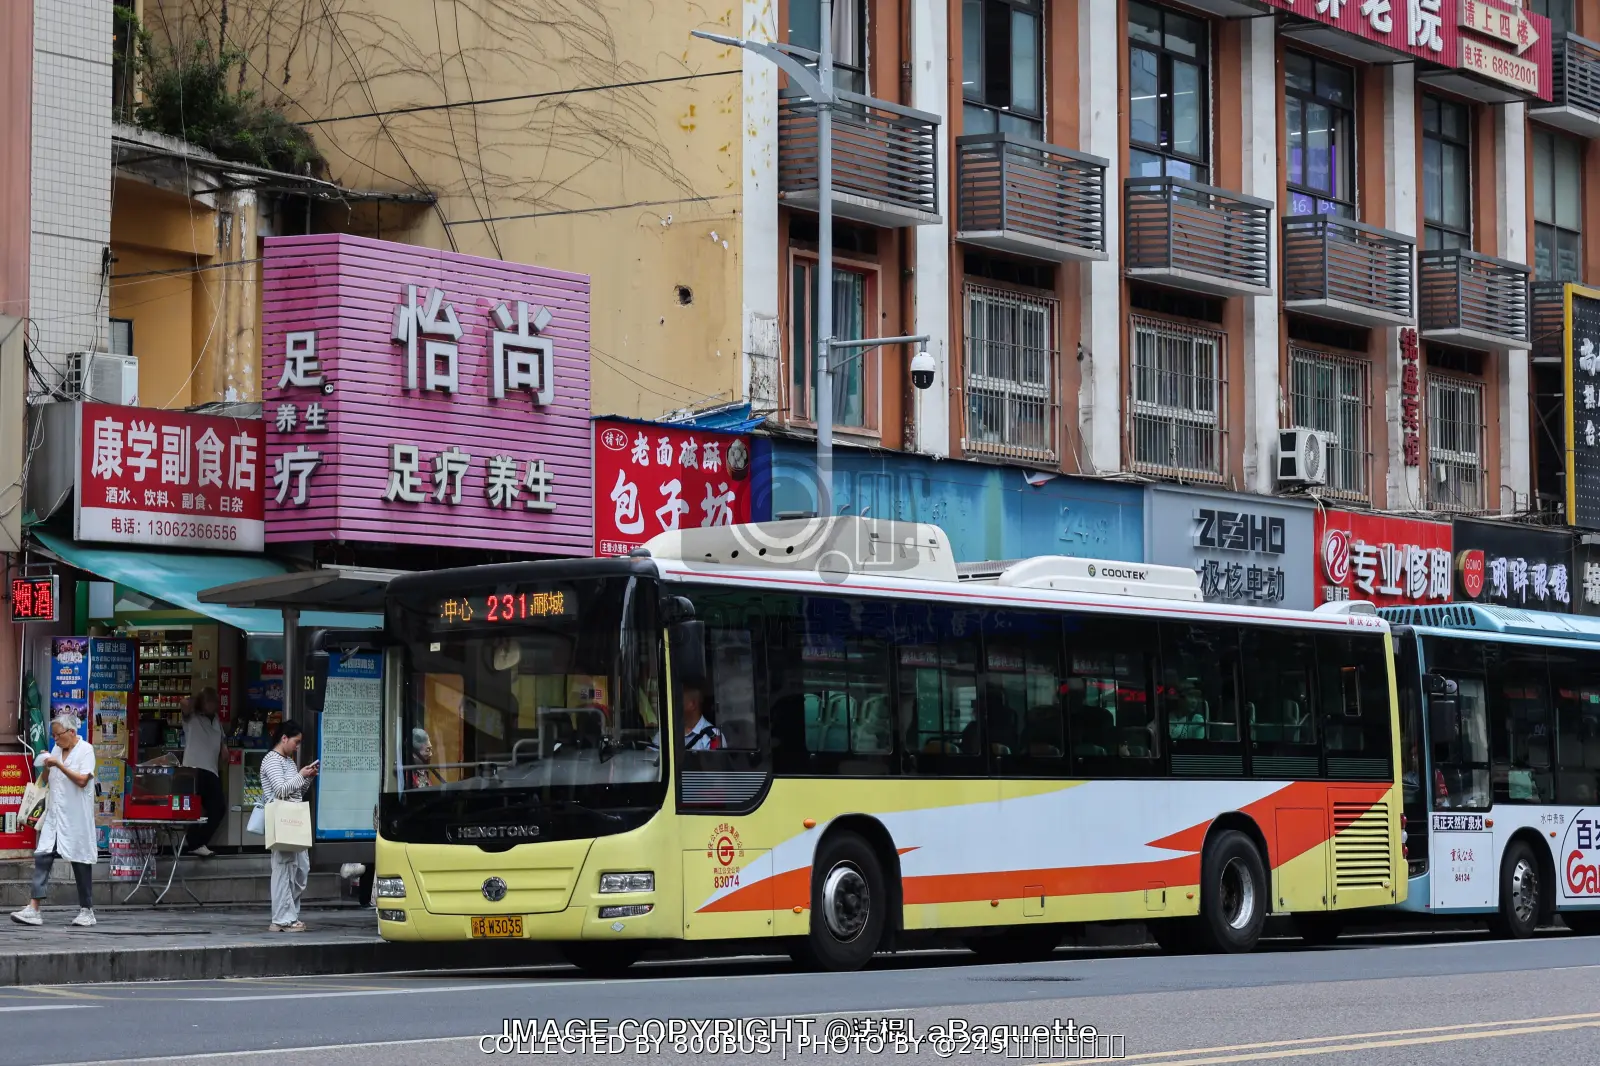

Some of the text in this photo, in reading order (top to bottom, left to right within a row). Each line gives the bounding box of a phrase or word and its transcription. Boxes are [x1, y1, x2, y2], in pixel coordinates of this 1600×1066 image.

[391, 283, 555, 406] 怡尚
[275, 403, 328, 433] 养生
[91, 416, 258, 491] 康学副食店
[631, 431, 722, 473] 老面破酥
[610, 468, 736, 535] 包子坊
[1101, 568, 1147, 580] COOLTEK
[1197, 559, 1285, 601] 极核电动
[1352, 540, 1451, 602] 专业修脚
[487, 594, 527, 621] 231
[458, 825, 540, 838] HENGTONG
[1433, 816, 1482, 830] 真正天然矿泉水
[714, 875, 740, 888] 83074
[1566, 850, 1600, 894] Ga
